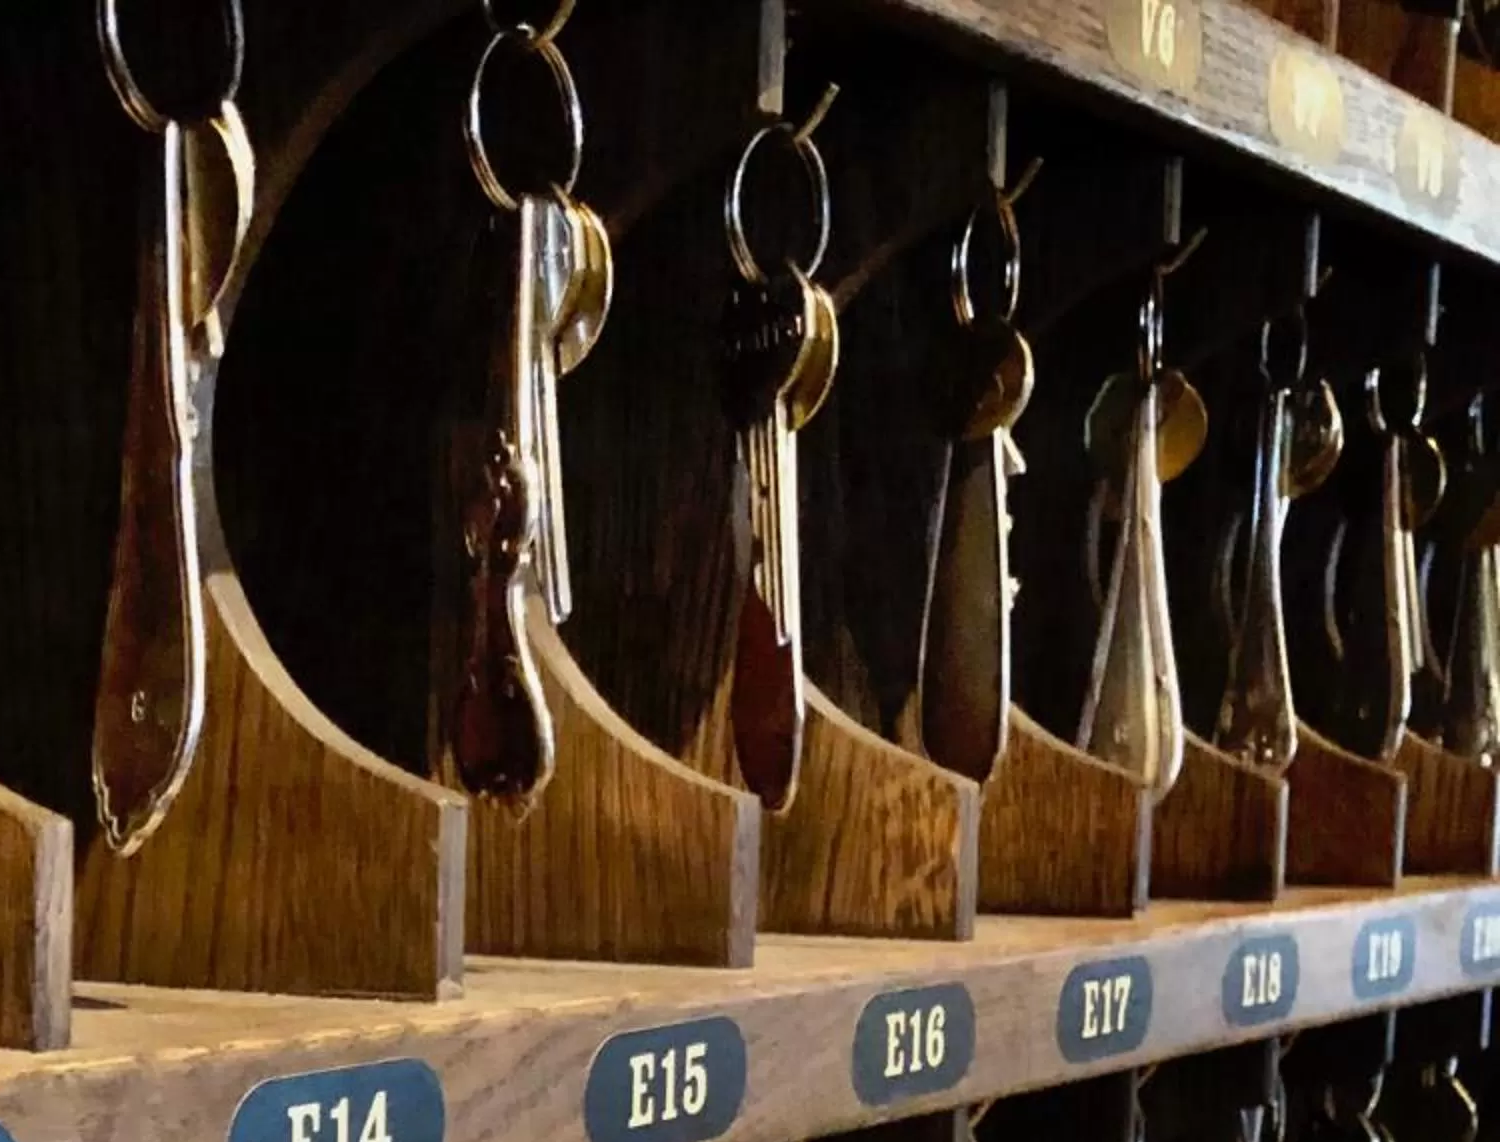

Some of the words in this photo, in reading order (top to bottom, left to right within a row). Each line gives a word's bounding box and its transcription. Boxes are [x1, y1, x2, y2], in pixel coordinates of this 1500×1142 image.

[1082, 975, 1133, 1039] E17
[1242, 951, 1282, 1007] E18
[884, 1004, 946, 1077] E16
[628, 1042, 708, 1129] E15
